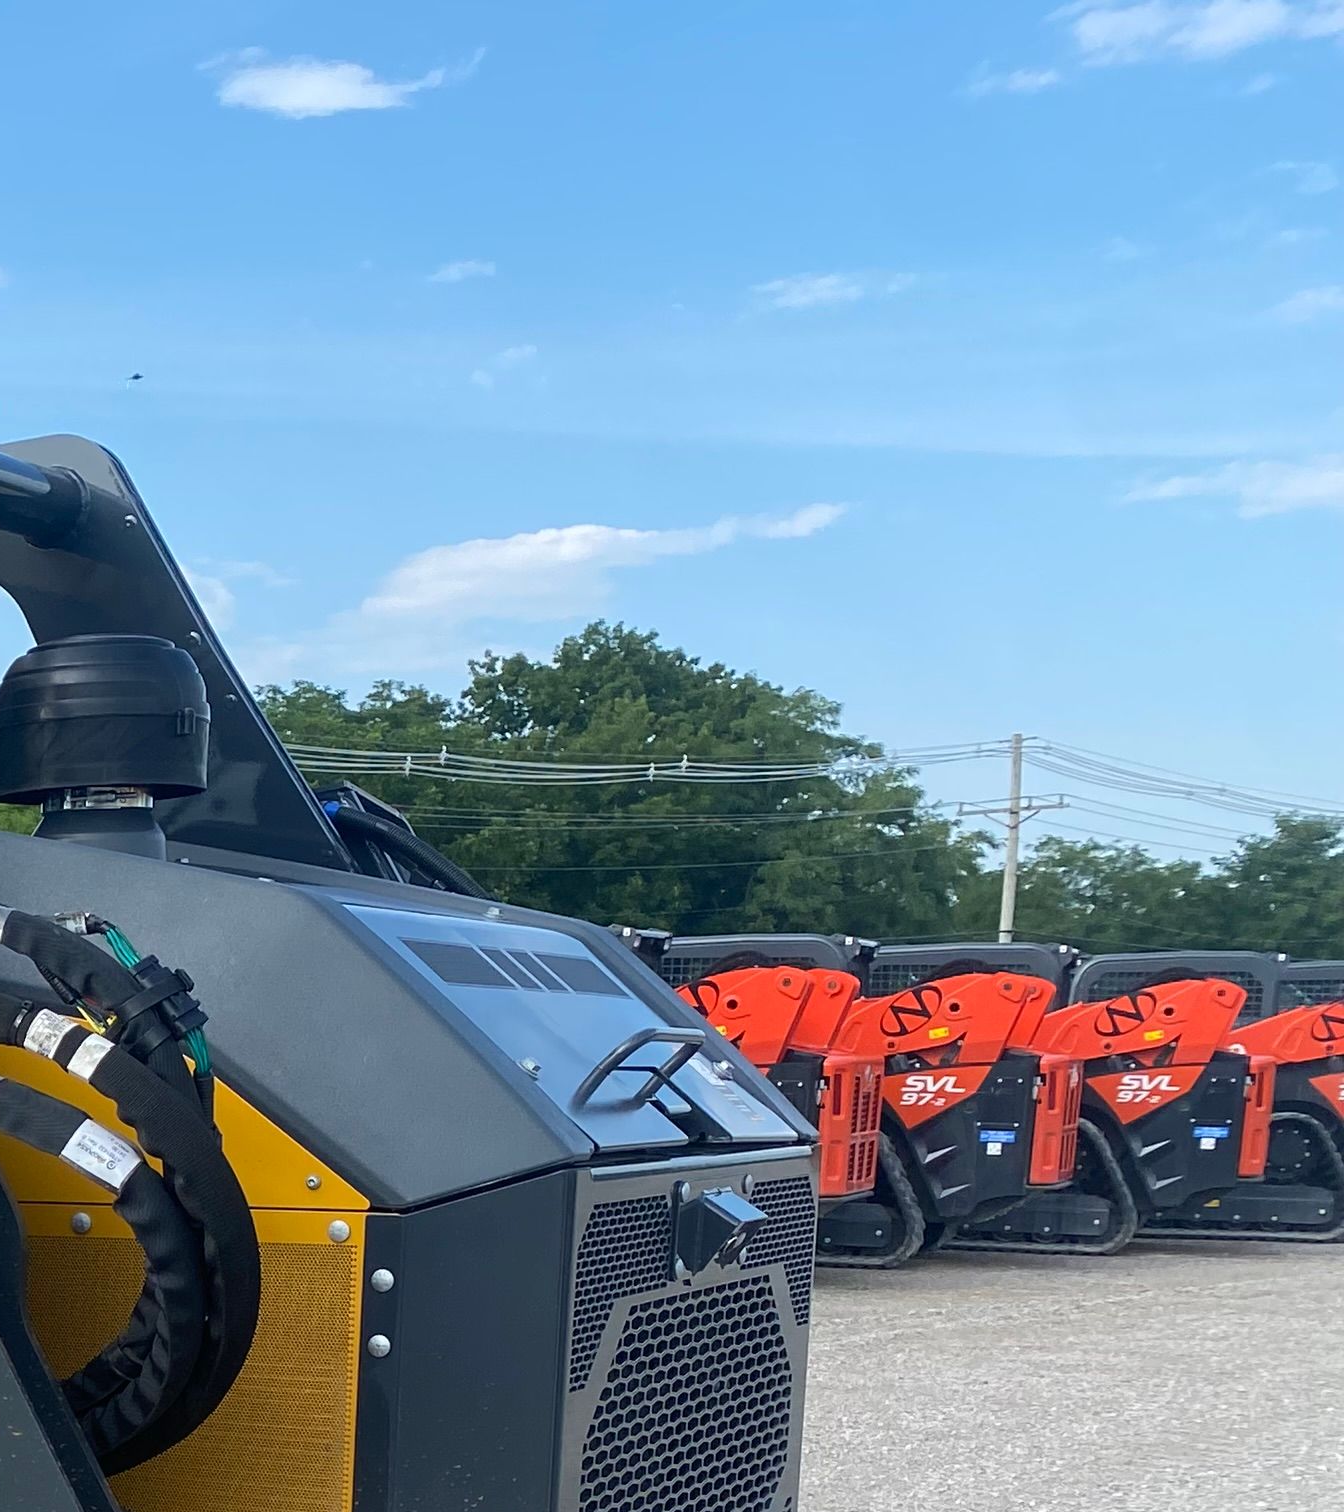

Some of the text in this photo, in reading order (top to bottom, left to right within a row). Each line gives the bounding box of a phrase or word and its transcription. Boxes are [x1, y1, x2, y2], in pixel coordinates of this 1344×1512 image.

[900, 1075, 966, 1093] SVL
[1116, 1075, 1181, 1092] SVL
[899, 1092, 947, 1107] 97-2
